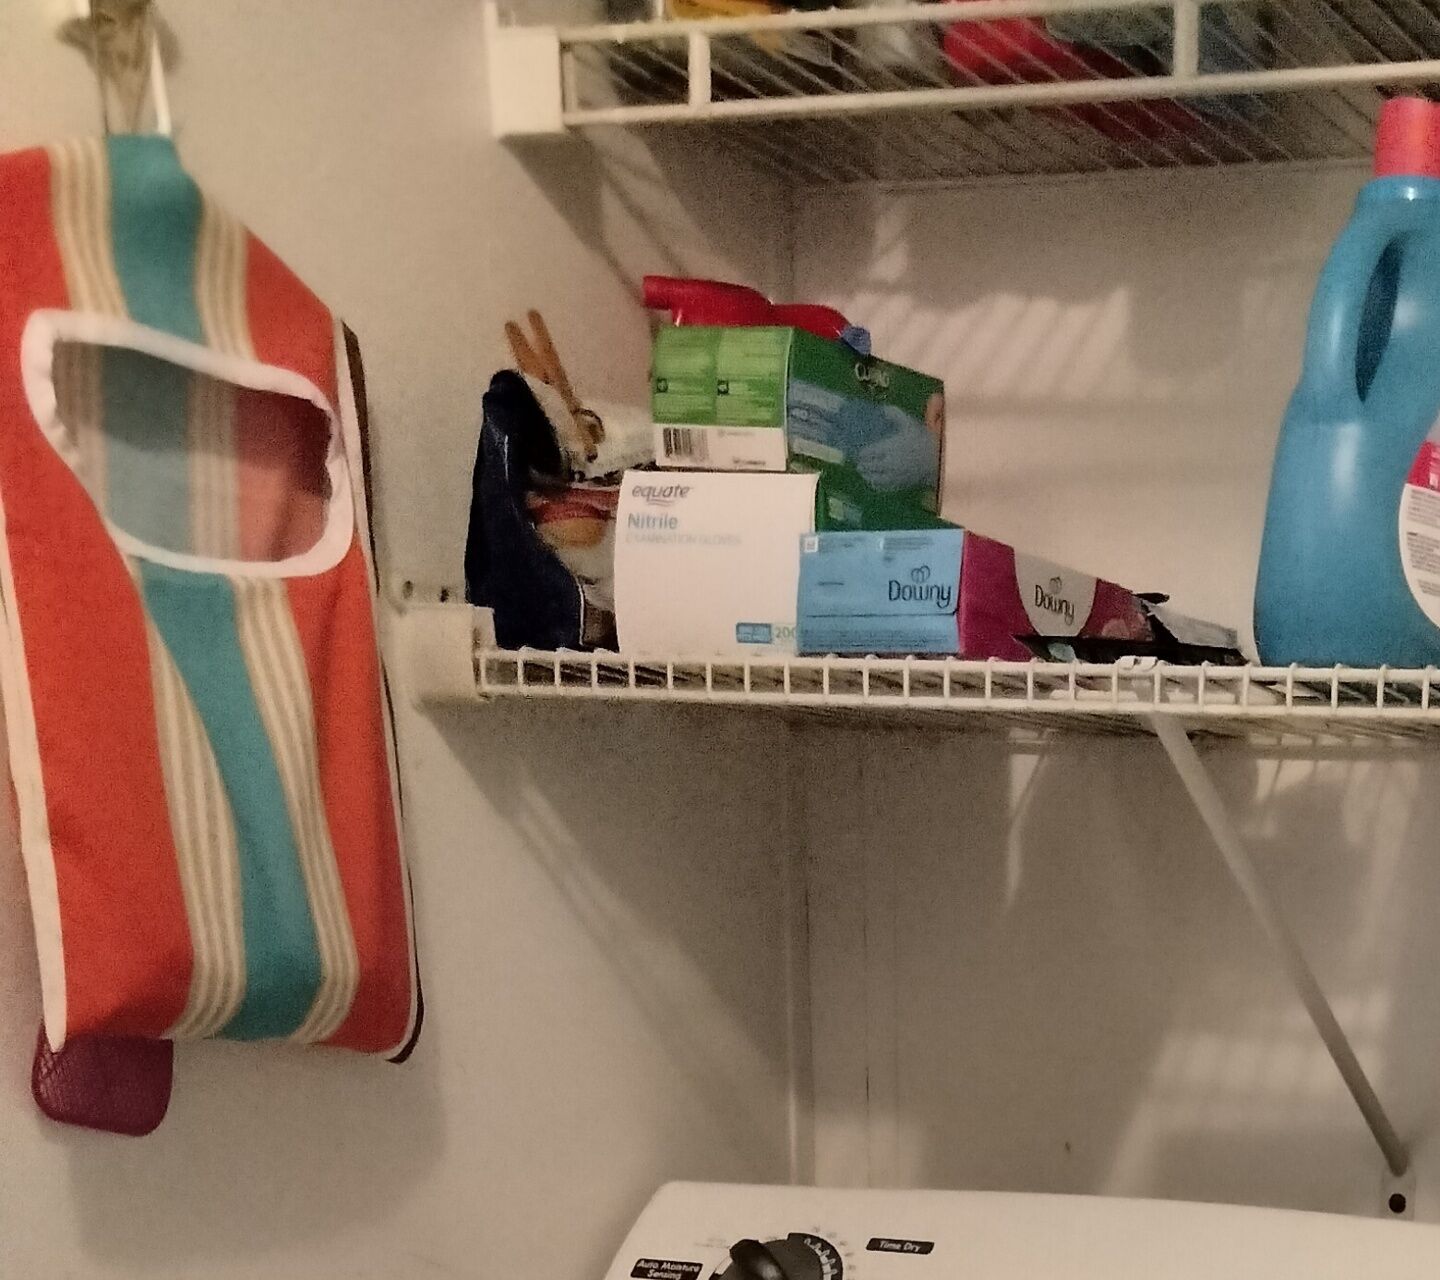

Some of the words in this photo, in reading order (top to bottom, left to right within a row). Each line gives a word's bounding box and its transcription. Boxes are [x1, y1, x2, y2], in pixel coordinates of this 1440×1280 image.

[632, 484, 692, 503] equate
[628, 513, 678, 529] Nitrile
[888, 580, 951, 608] Downy
[1035, 585, 1074, 626] Downy
[880, 1241, 901, 1250] Time
[903, 1242, 920, 1252] Dry
[637, 1260, 659, 1269] Auto
[661, 1262, 701, 1273] Moisture
[647, 1269, 682, 1280] Sensing
